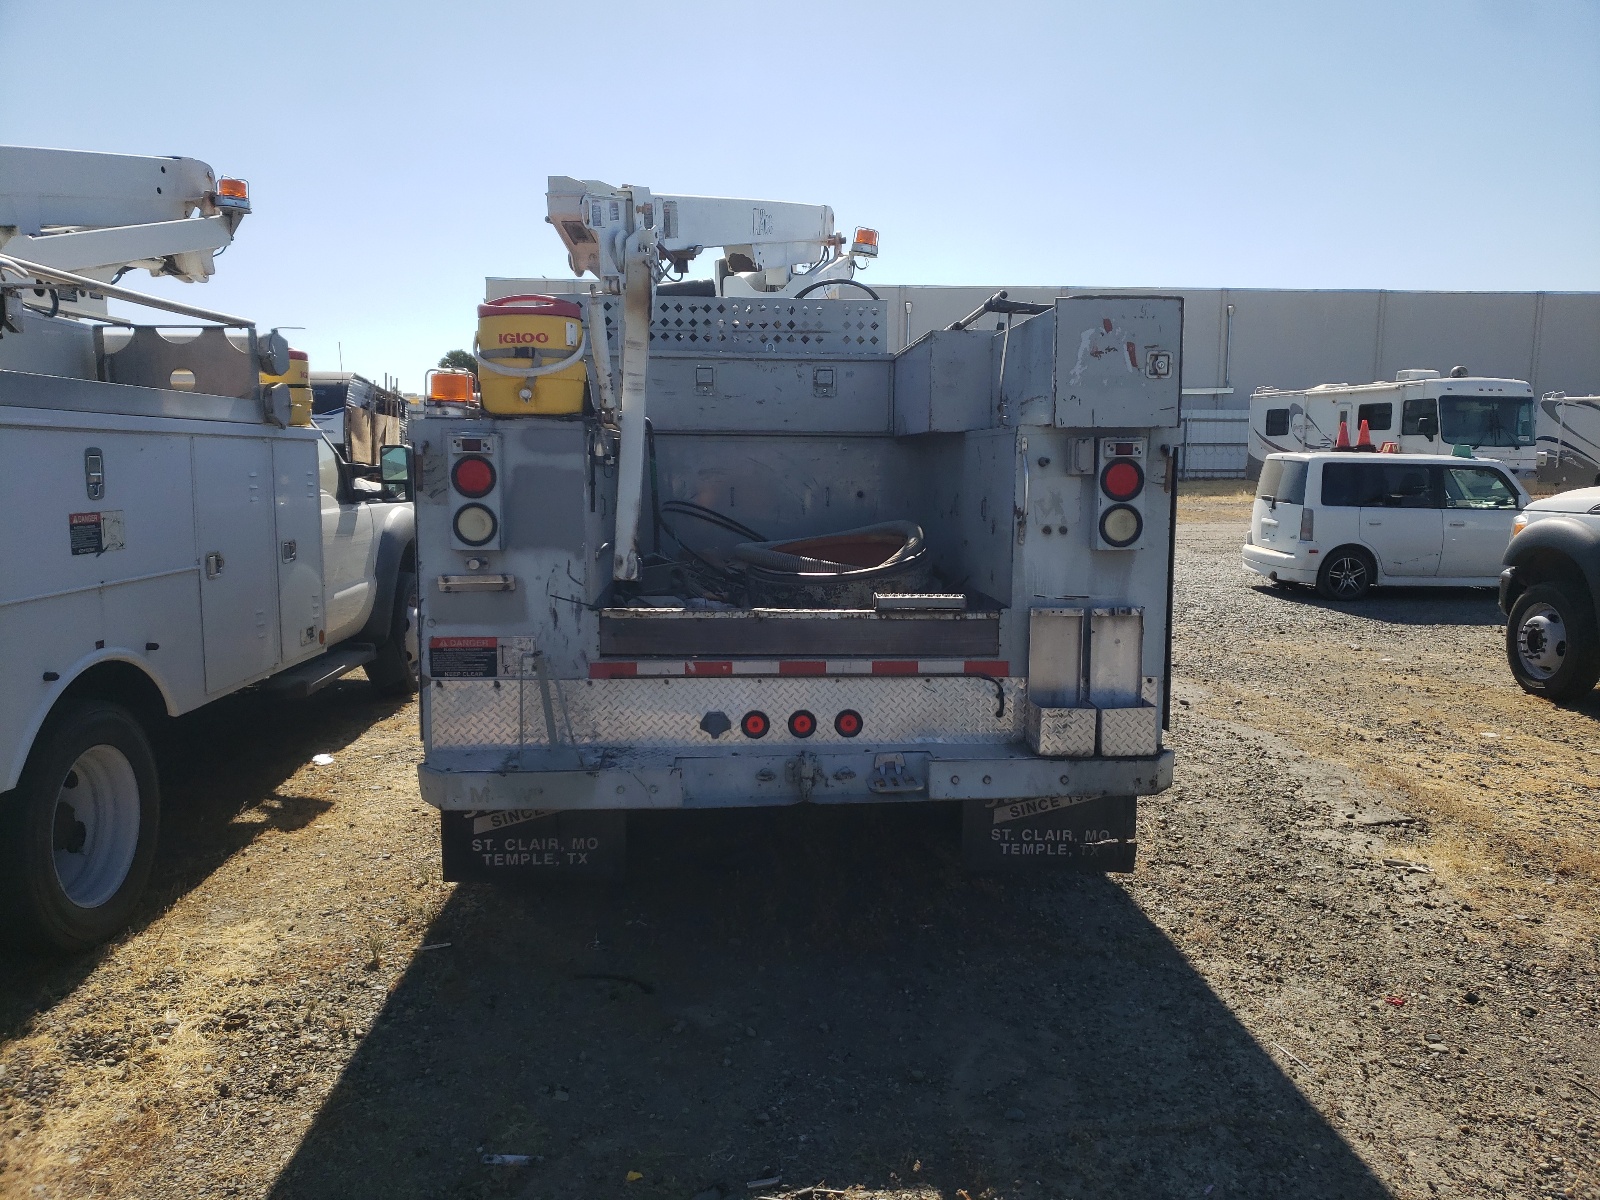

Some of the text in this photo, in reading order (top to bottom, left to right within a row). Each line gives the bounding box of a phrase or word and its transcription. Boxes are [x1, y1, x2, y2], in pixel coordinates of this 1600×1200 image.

[498, 332, 549, 344] IGLOO
[450, 639, 489, 647] DANGER
[1010, 796, 1061, 818] SINCE
[990, 828, 1111, 843] ST. CLAIR, MO
[471, 837, 599, 852] ST. CLAIR, MO
[999, 842, 1100, 858] TEMPLE, TX
[482, 852, 589, 867] TEMPLE, TX
